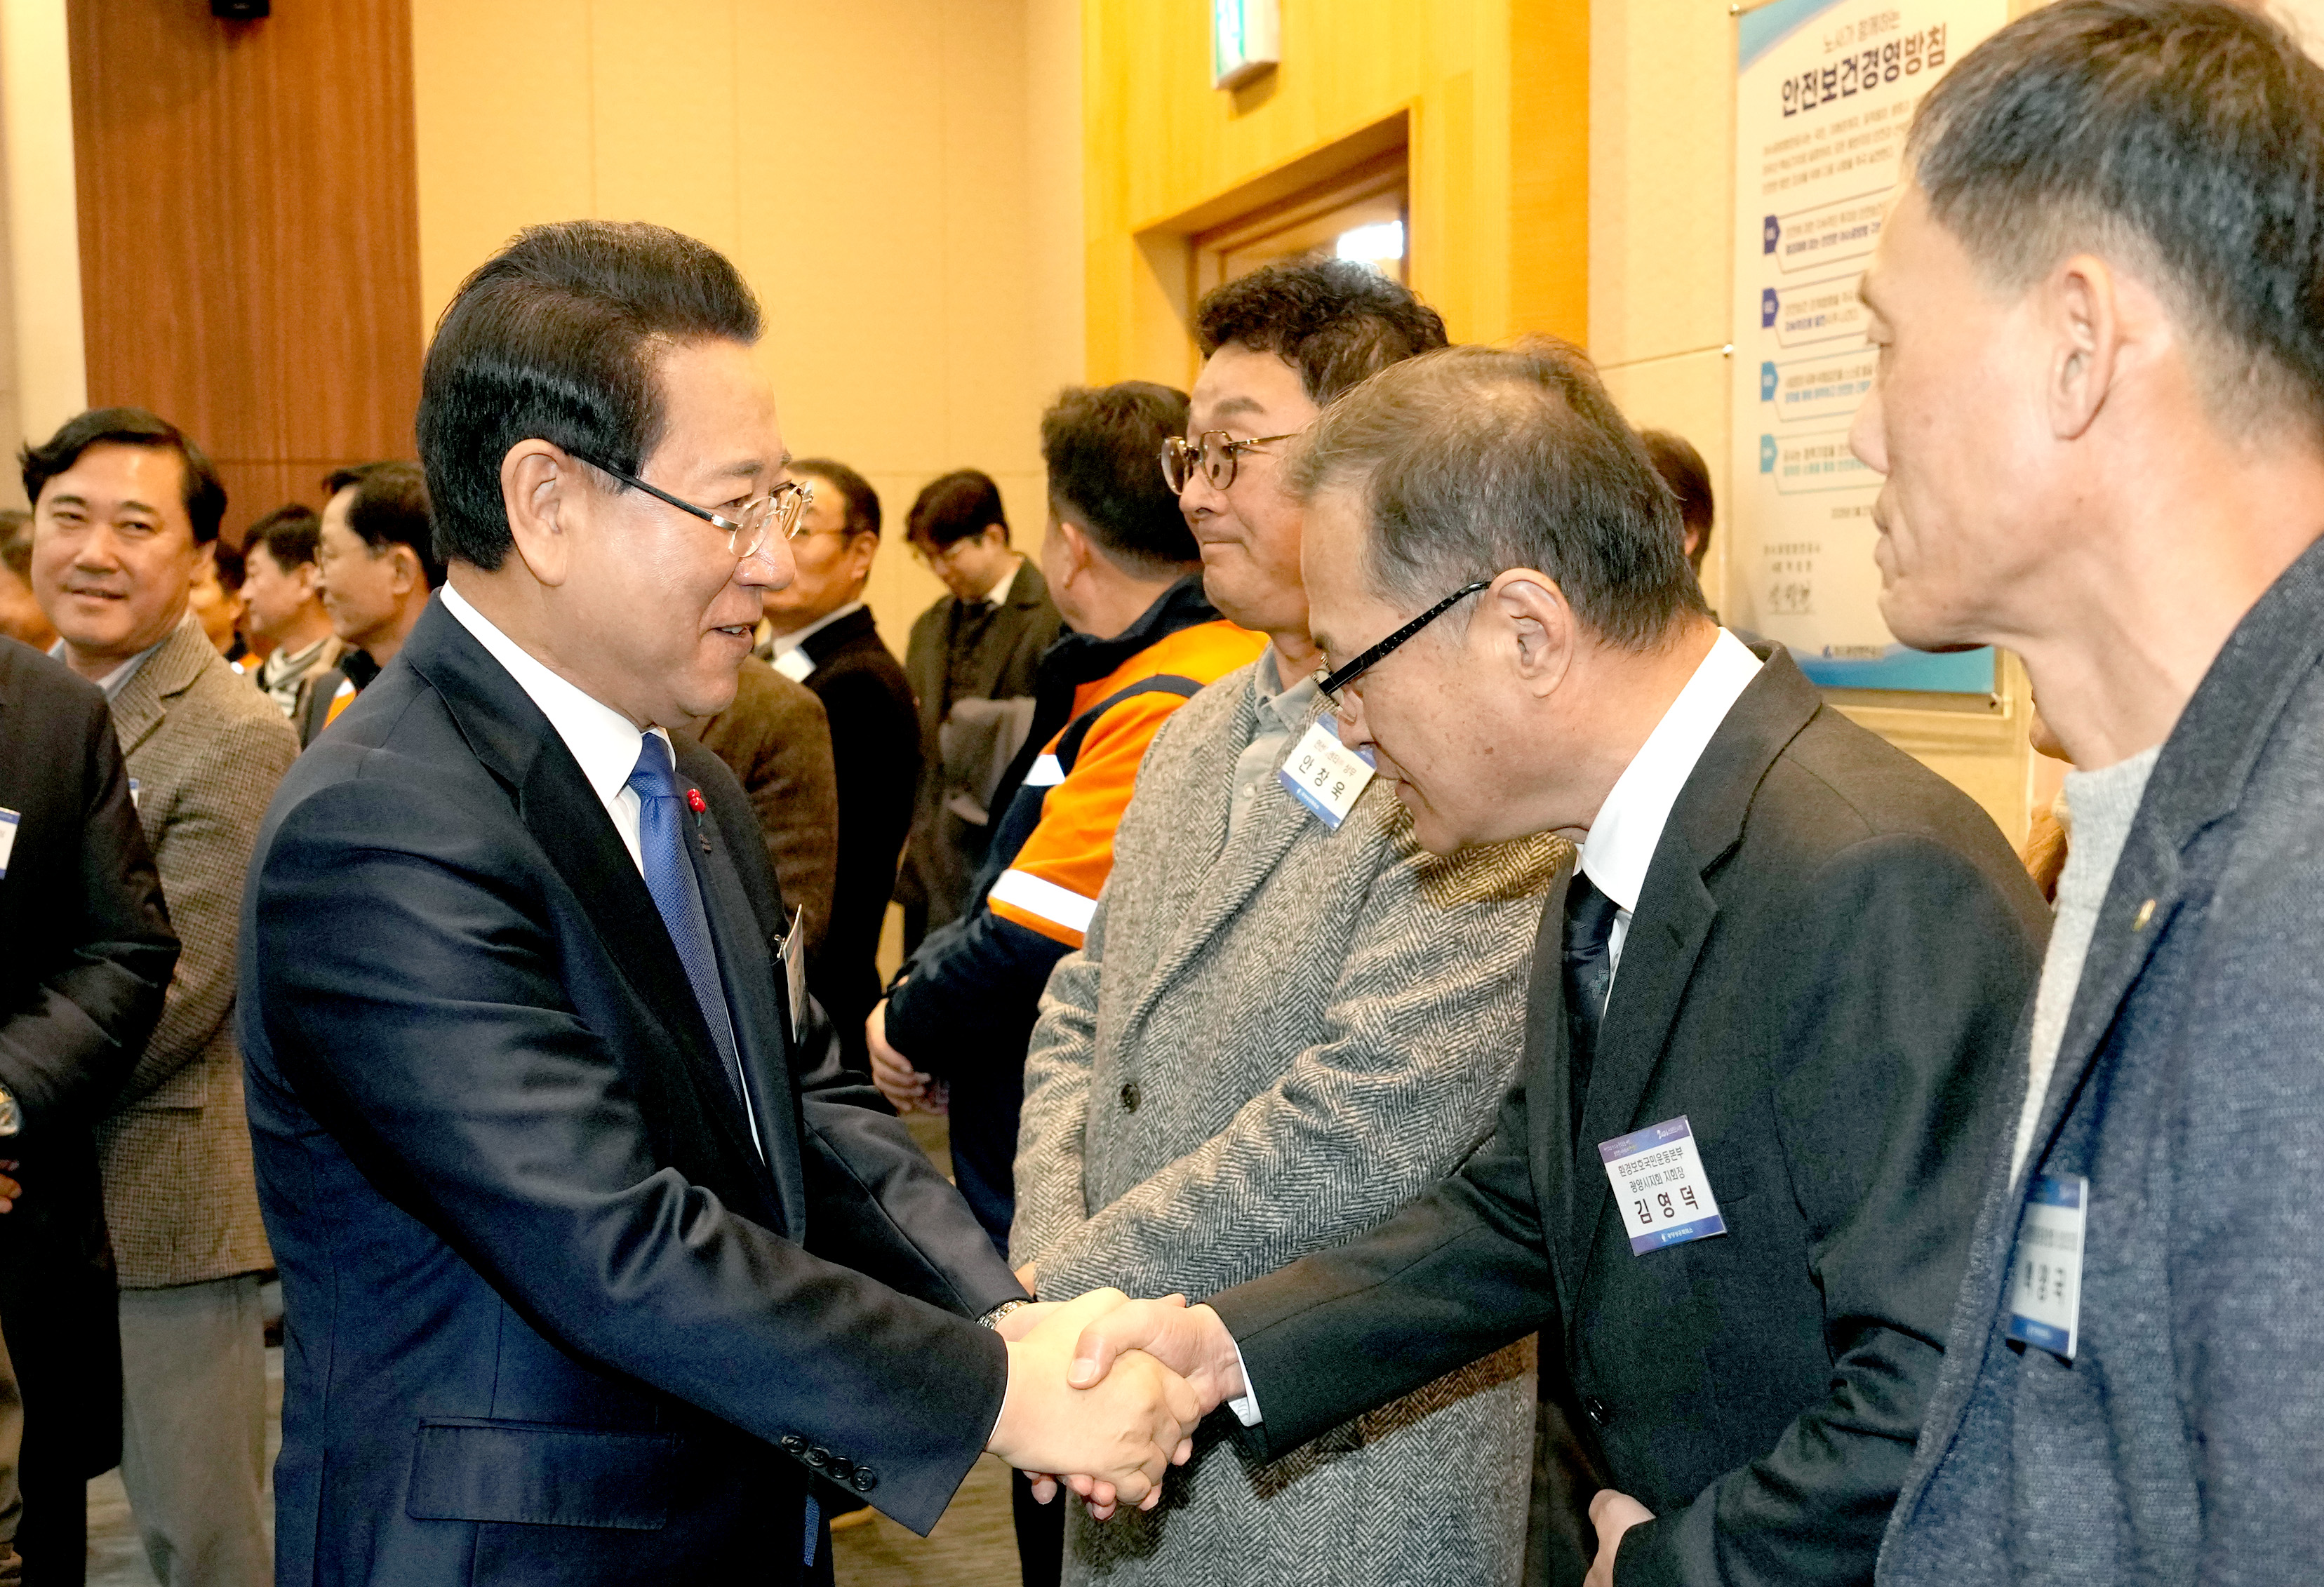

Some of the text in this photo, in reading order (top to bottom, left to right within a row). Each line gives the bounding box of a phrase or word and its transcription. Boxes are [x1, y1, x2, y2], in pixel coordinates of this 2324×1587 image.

[1782, 22, 1946, 118] 안전보건경영방침
[1618, 1146, 1684, 1177] 환경보호국민운동본부
[1629, 1167, 1685, 1193] 광양시지회 지회장
